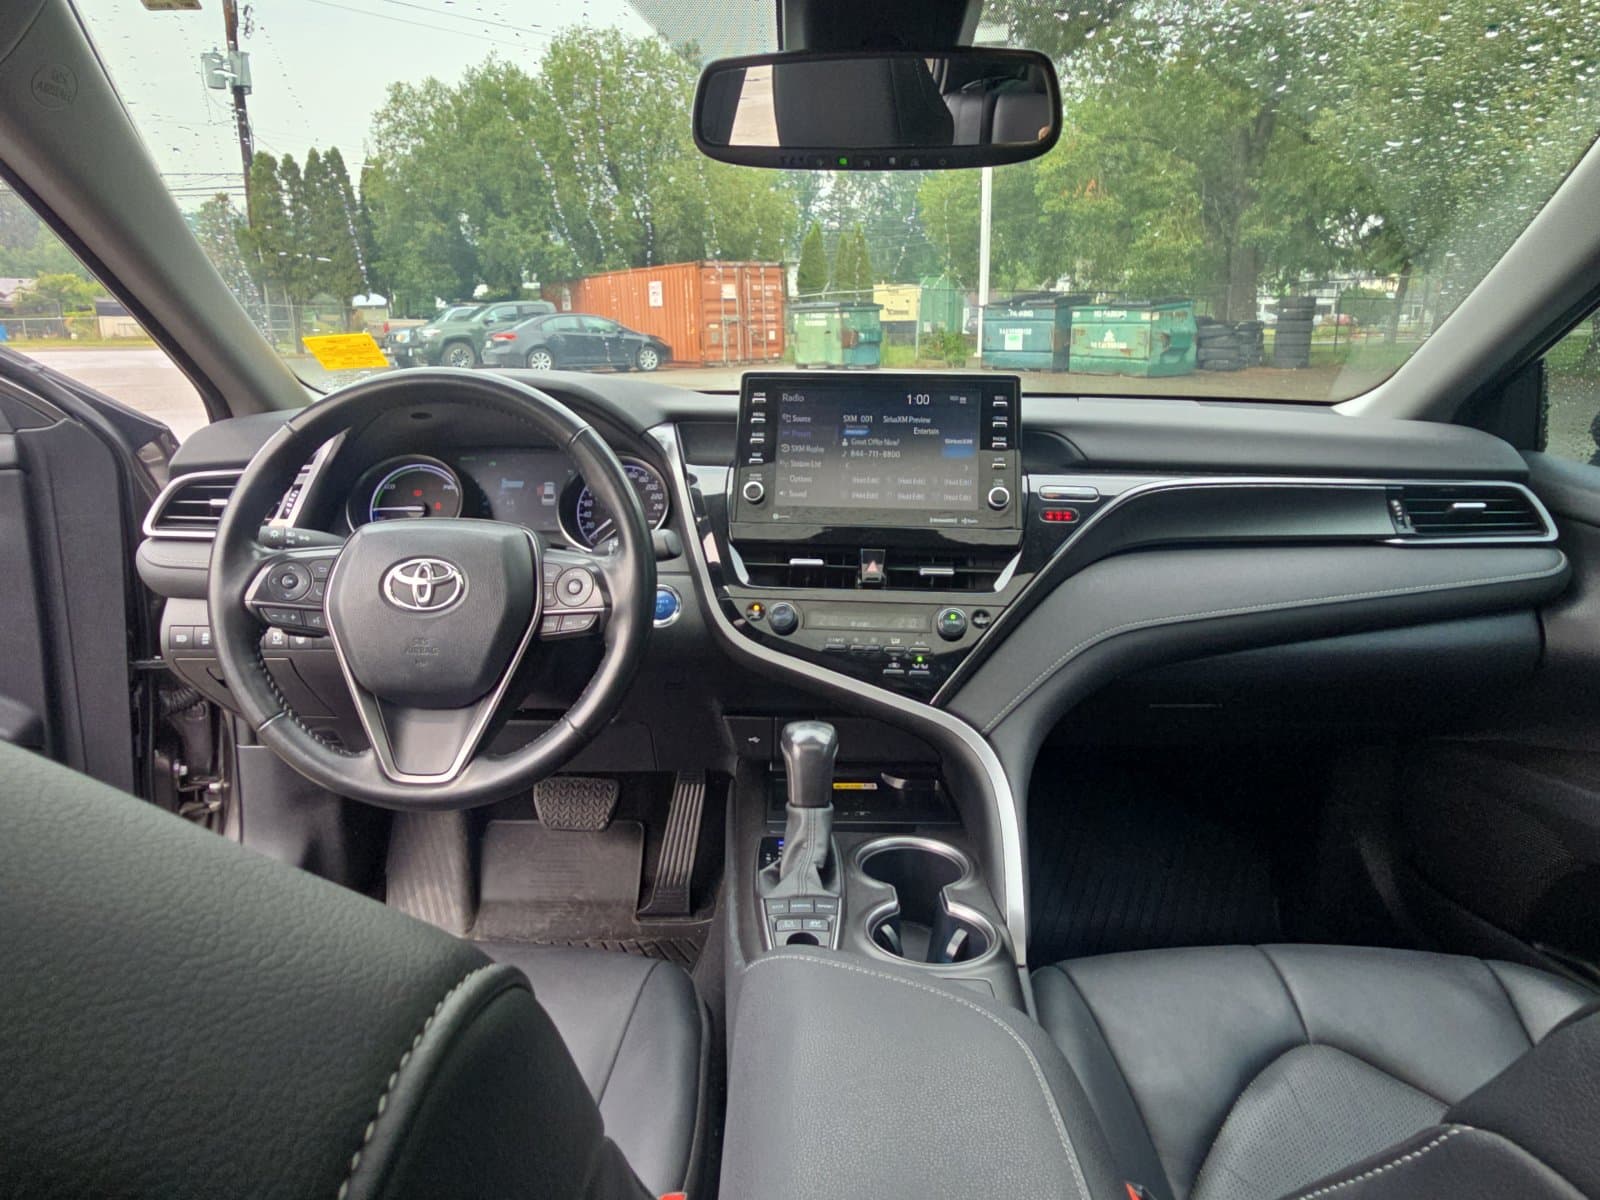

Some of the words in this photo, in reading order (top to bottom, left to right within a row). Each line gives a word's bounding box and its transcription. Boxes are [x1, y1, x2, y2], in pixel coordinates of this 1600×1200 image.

[782, 392, 805, 402] Radio
[906, 393, 930, 405] 1:00
[842, 415, 858, 423] SXM
[860, 415, 873, 423] 001
[882, 415, 908, 424] SiriusXM
[908, 415, 931, 424] Preview
